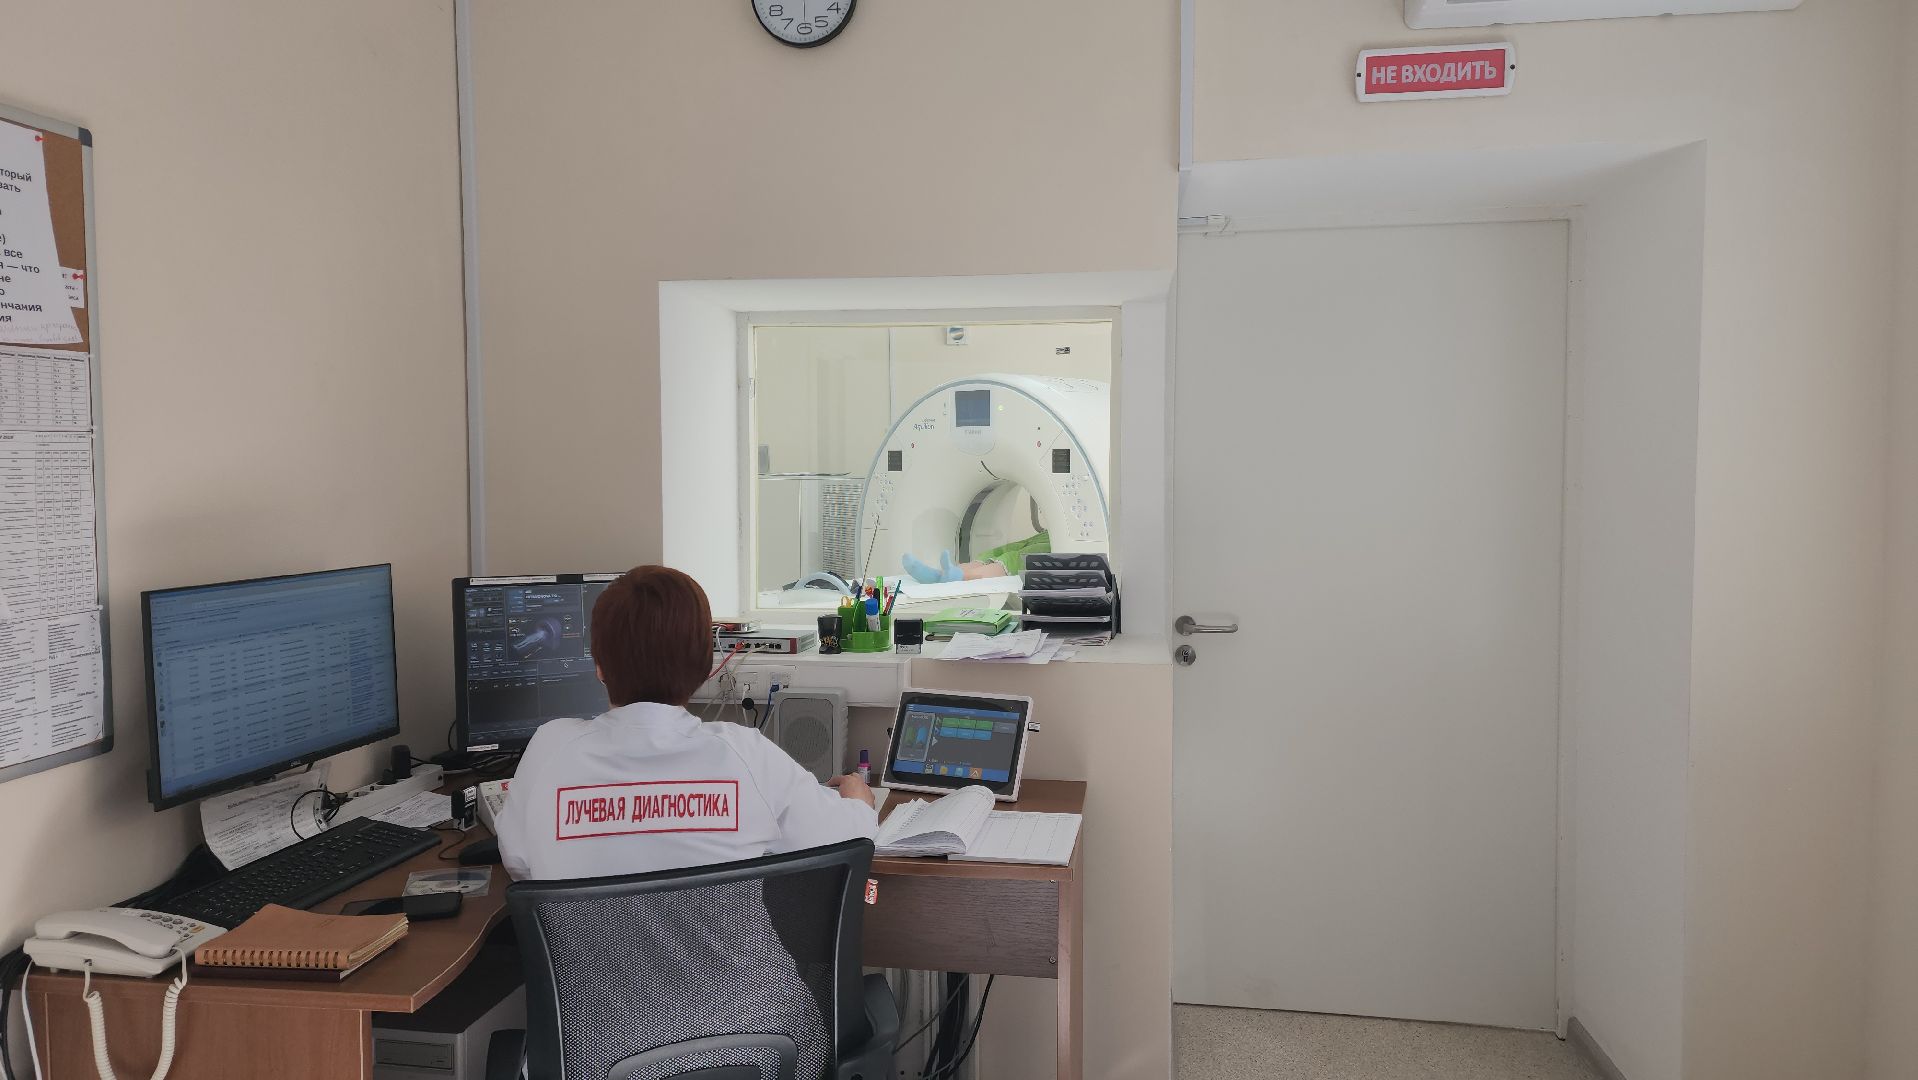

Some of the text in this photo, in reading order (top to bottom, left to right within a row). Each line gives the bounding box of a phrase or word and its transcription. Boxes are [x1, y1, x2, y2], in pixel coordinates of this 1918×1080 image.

[769, 4, 784, 17] 8
[827, 2, 841, 14] 4
[781, 17, 794, 31] 7
[814, 15, 829, 28] 5
[796, 22, 813, 35] 6
[1371, 60, 1497, 85] НЕ ВХОДИТЬ
[0, 168, 32, 182] торый
[4, 249, 23, 259] все
[21, 264, 40, 274] что
[1, 302, 42, 312] нчания
[565, 793, 729, 825] ЛУЧЕВАЯ ДИАГНОСТИКА
